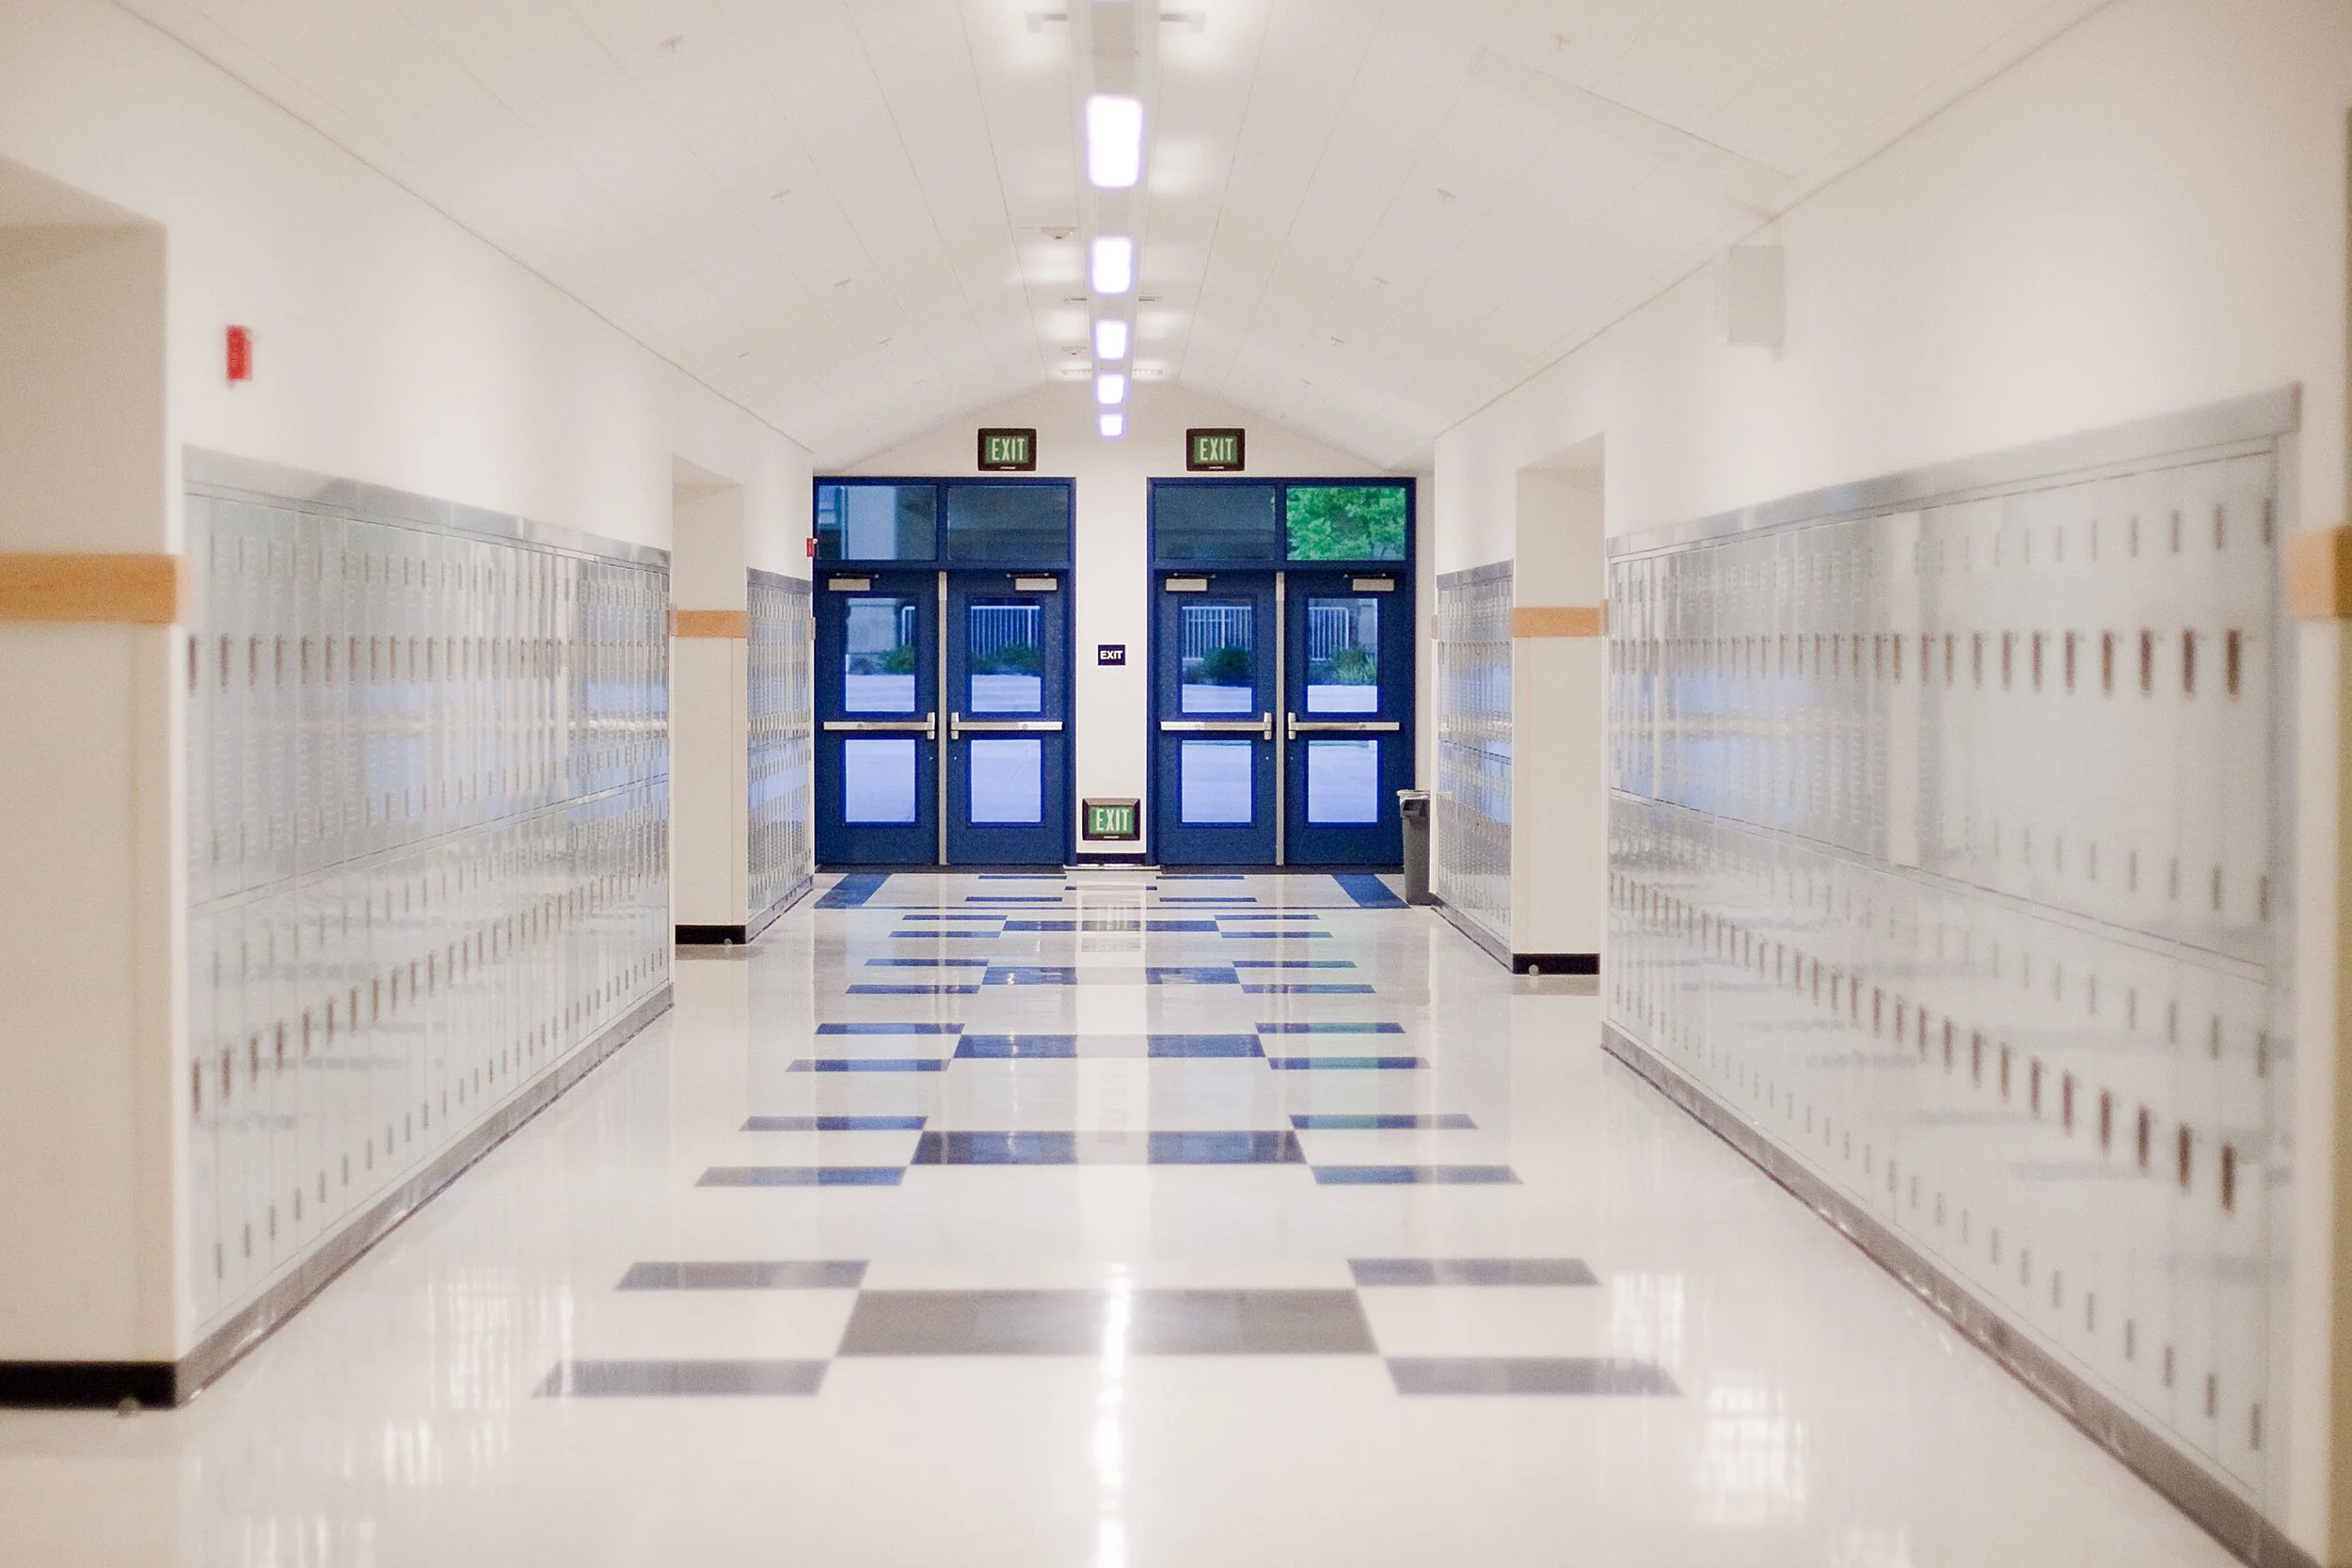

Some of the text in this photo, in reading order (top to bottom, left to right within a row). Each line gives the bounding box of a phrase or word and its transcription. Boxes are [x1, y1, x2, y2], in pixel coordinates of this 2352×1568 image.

[992, 438, 1025, 461] EXIT
[1200, 438, 1233, 461] EXIT
[1101, 651, 1123, 659] EXIT
[1096, 809, 1130, 832] EXIT
